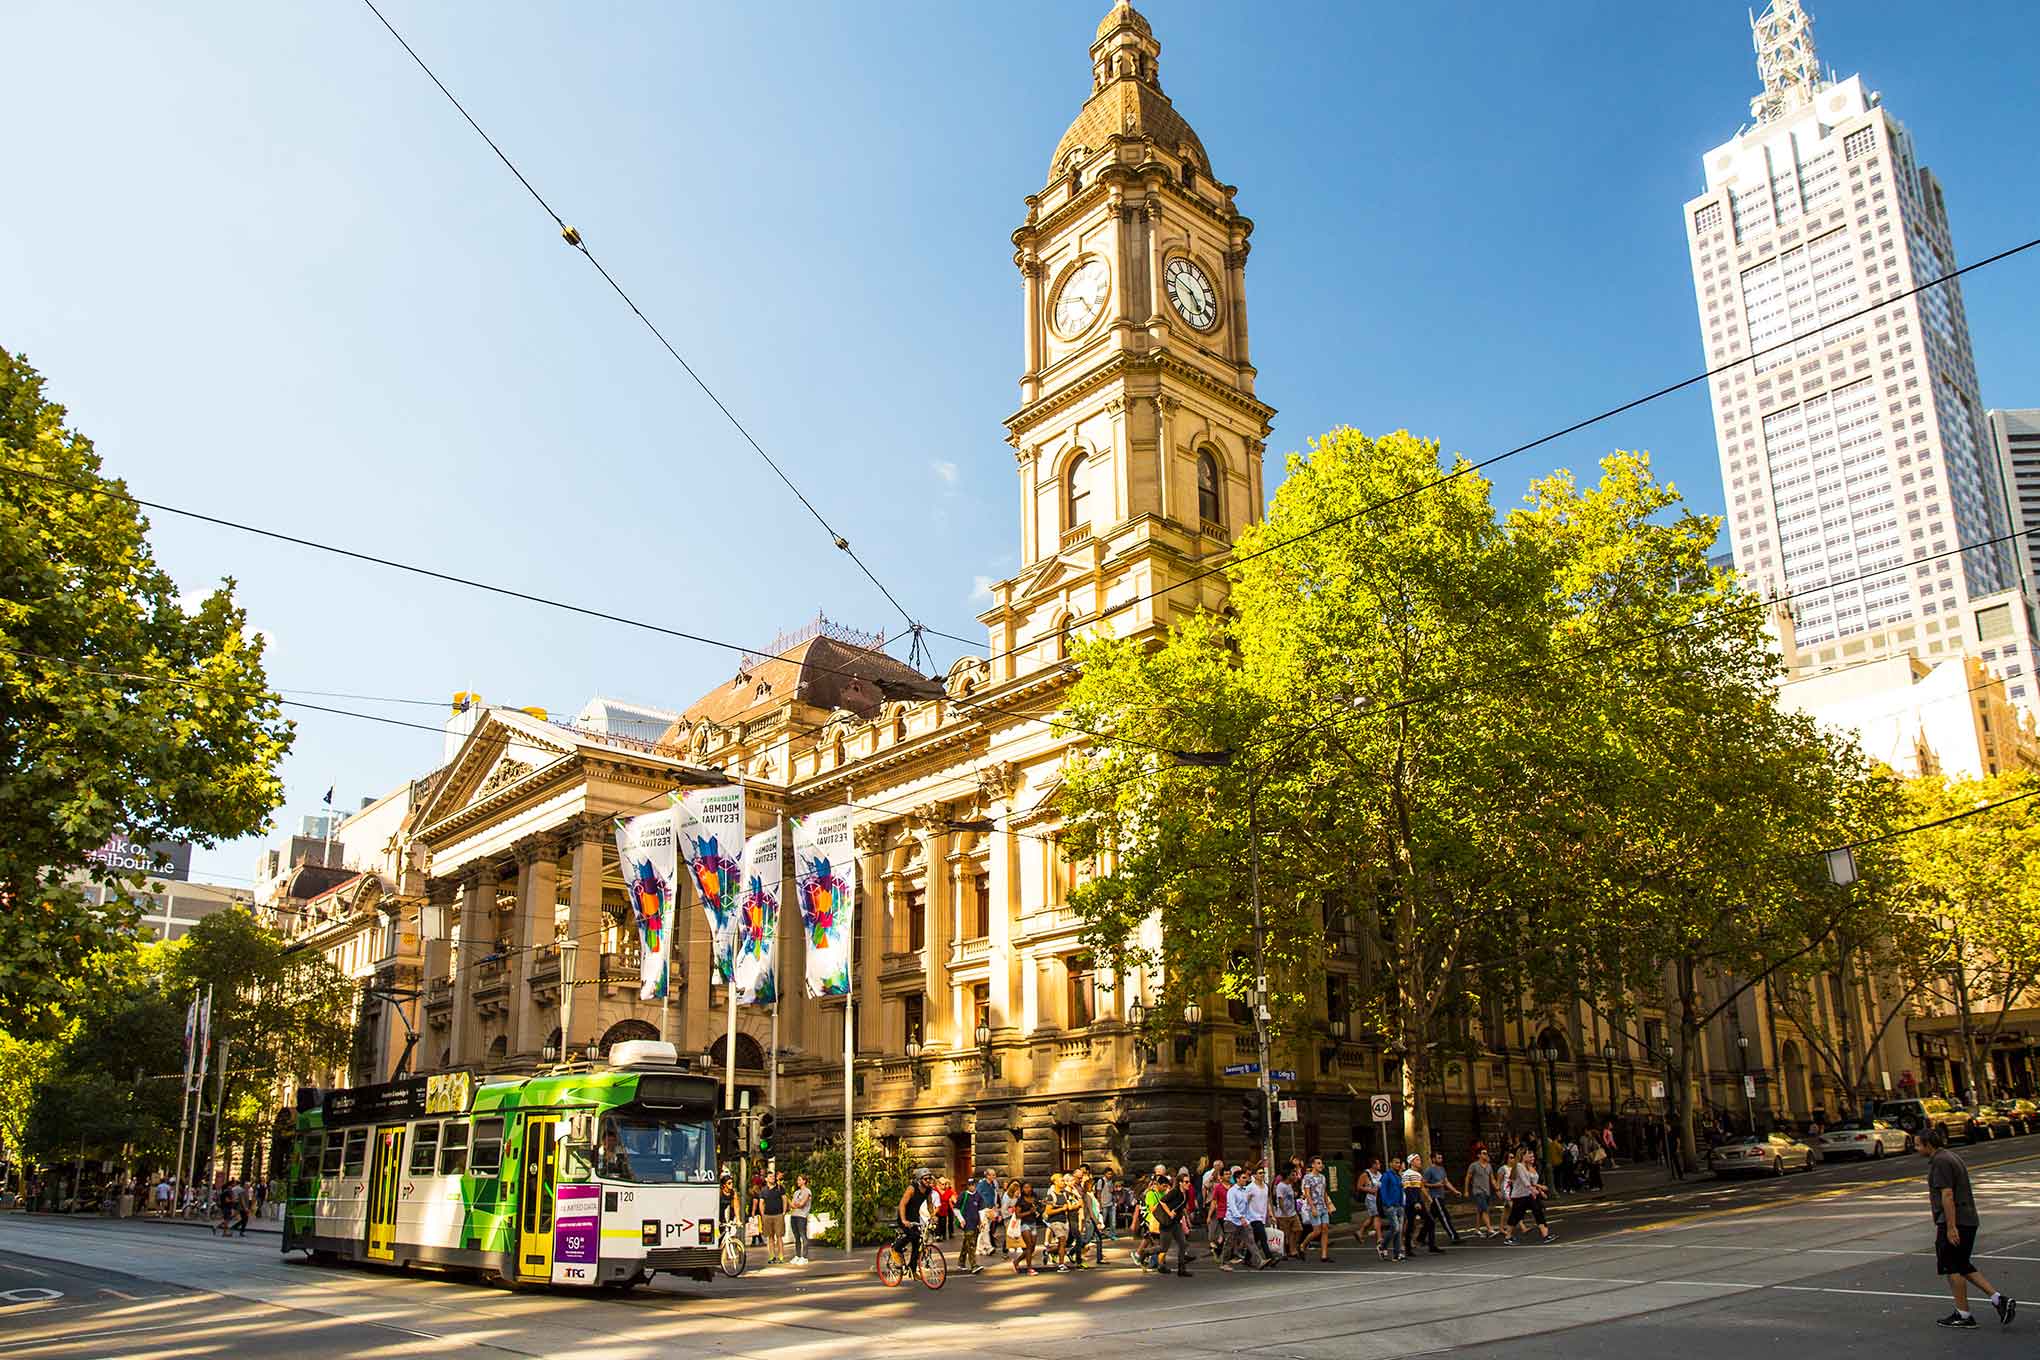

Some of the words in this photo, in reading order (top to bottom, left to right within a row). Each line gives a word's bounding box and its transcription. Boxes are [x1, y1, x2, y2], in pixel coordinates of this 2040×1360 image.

[1374, 1103, 1389, 1113] 40
[694, 1169, 714, 1181] 120
[620, 1191, 634, 1202] 120
